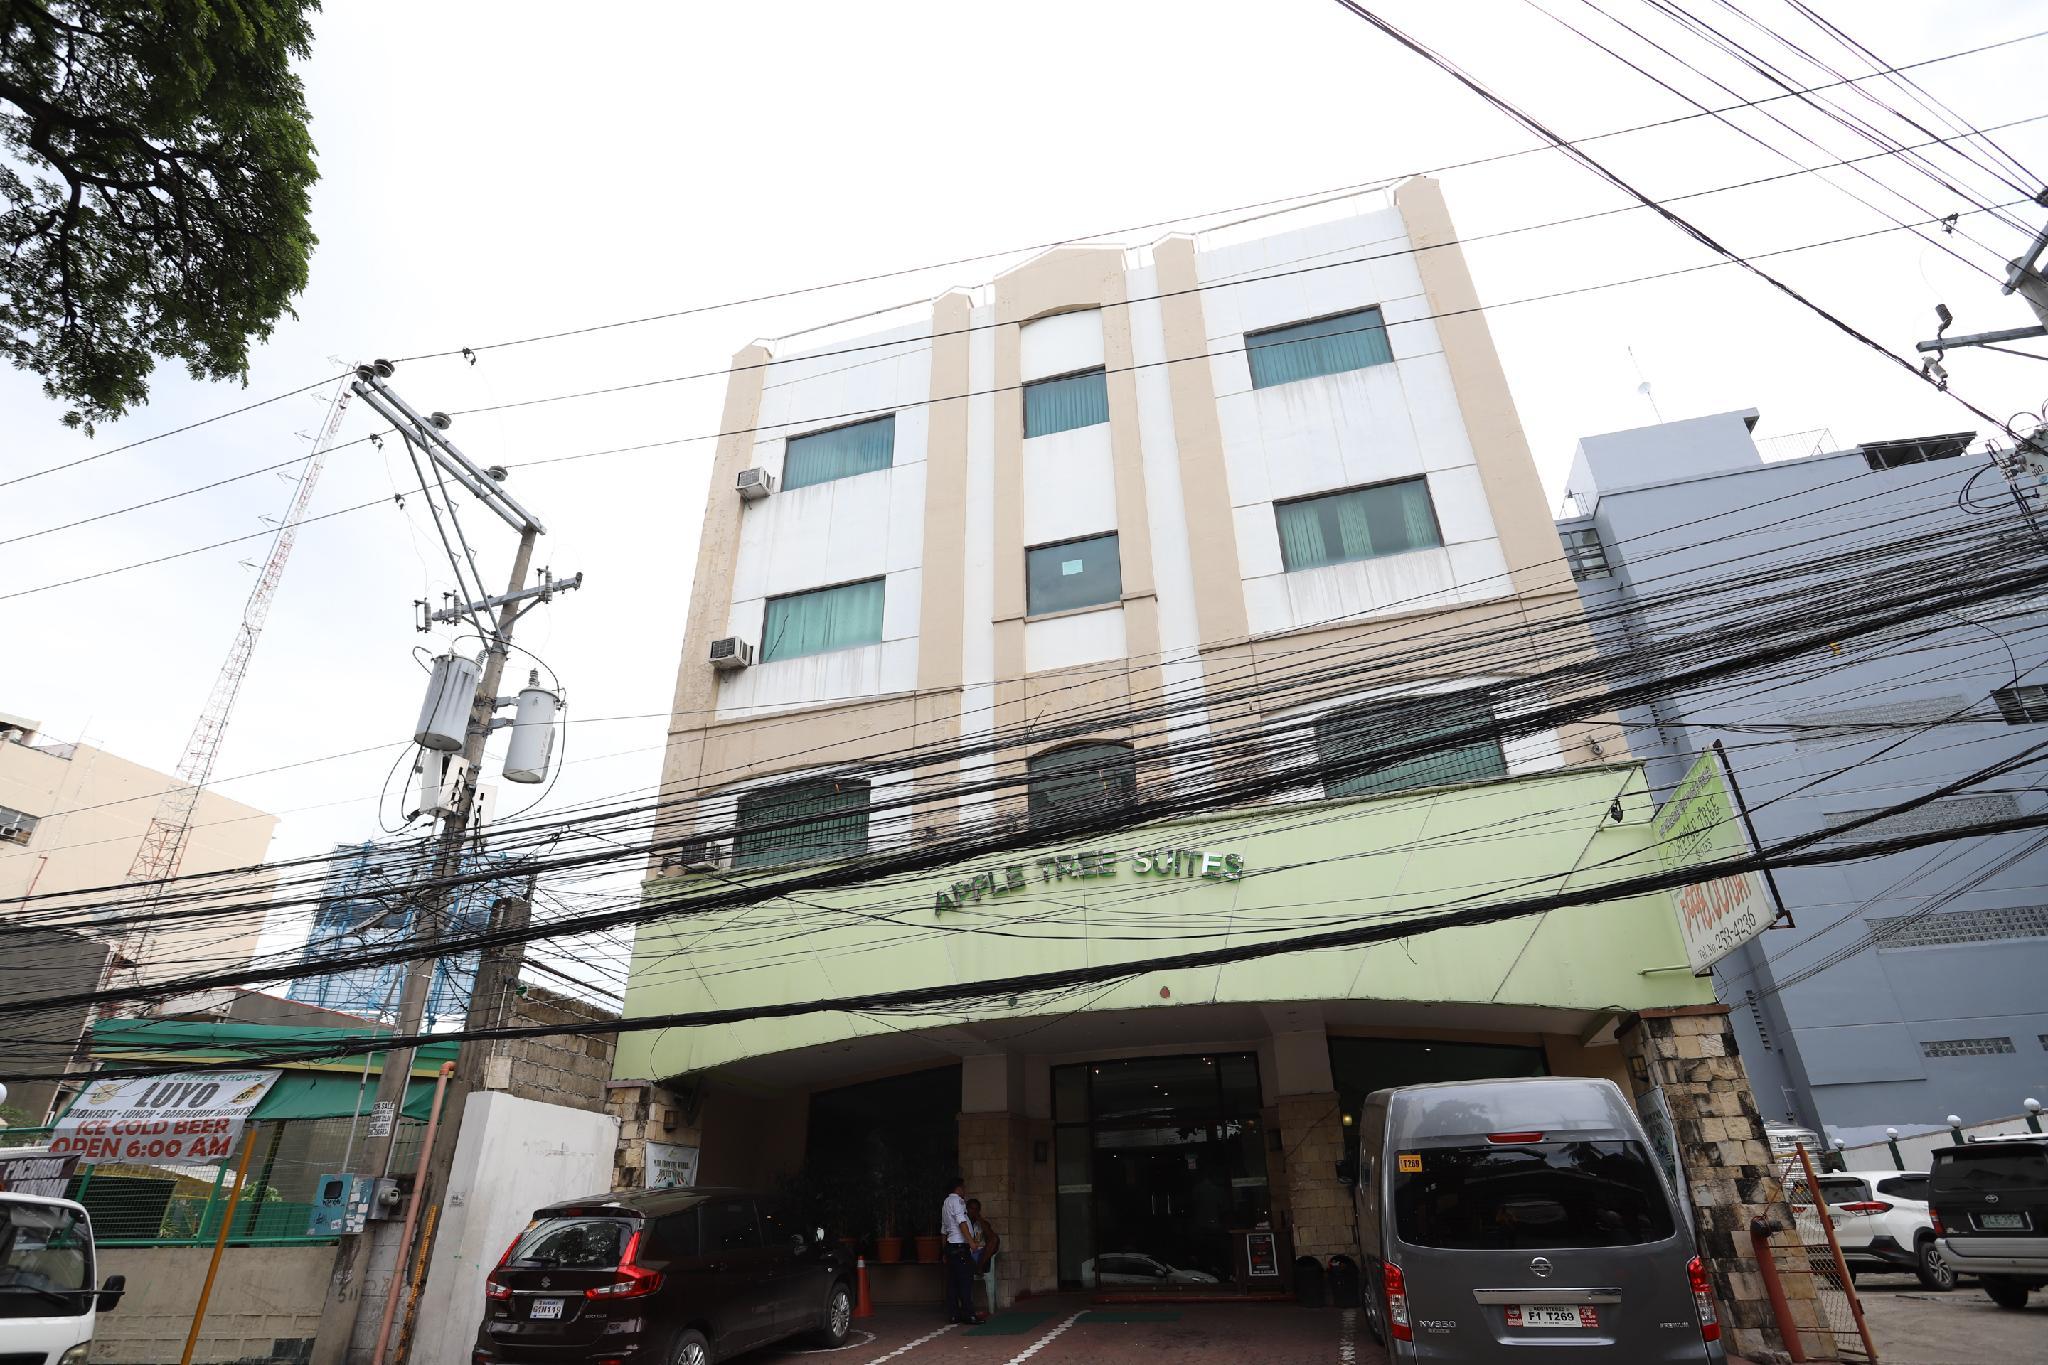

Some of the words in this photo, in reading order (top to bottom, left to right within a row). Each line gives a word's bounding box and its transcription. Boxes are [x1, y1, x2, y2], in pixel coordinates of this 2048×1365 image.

[935, 864, 1026, 917] APPLE
[1036, 851, 1117, 881] TREE
[1131, 849, 1245, 881] SUITES
[134, 1083, 220, 1109] LUYO
[122, 1109, 156, 1119] LUNCH
[76, 1120, 111, 1136] ICE
[112, 1119, 172, 1136] COLD
[173, 1118, 231, 1135] BEER
[50, 1137, 122, 1158] OPEN
[126, 1139, 182, 1158] 6:00
[187, 1136, 233, 1158] AM
[1528, 1312, 1541, 1321] F1
[1546, 1312, 1575, 1321] T269
